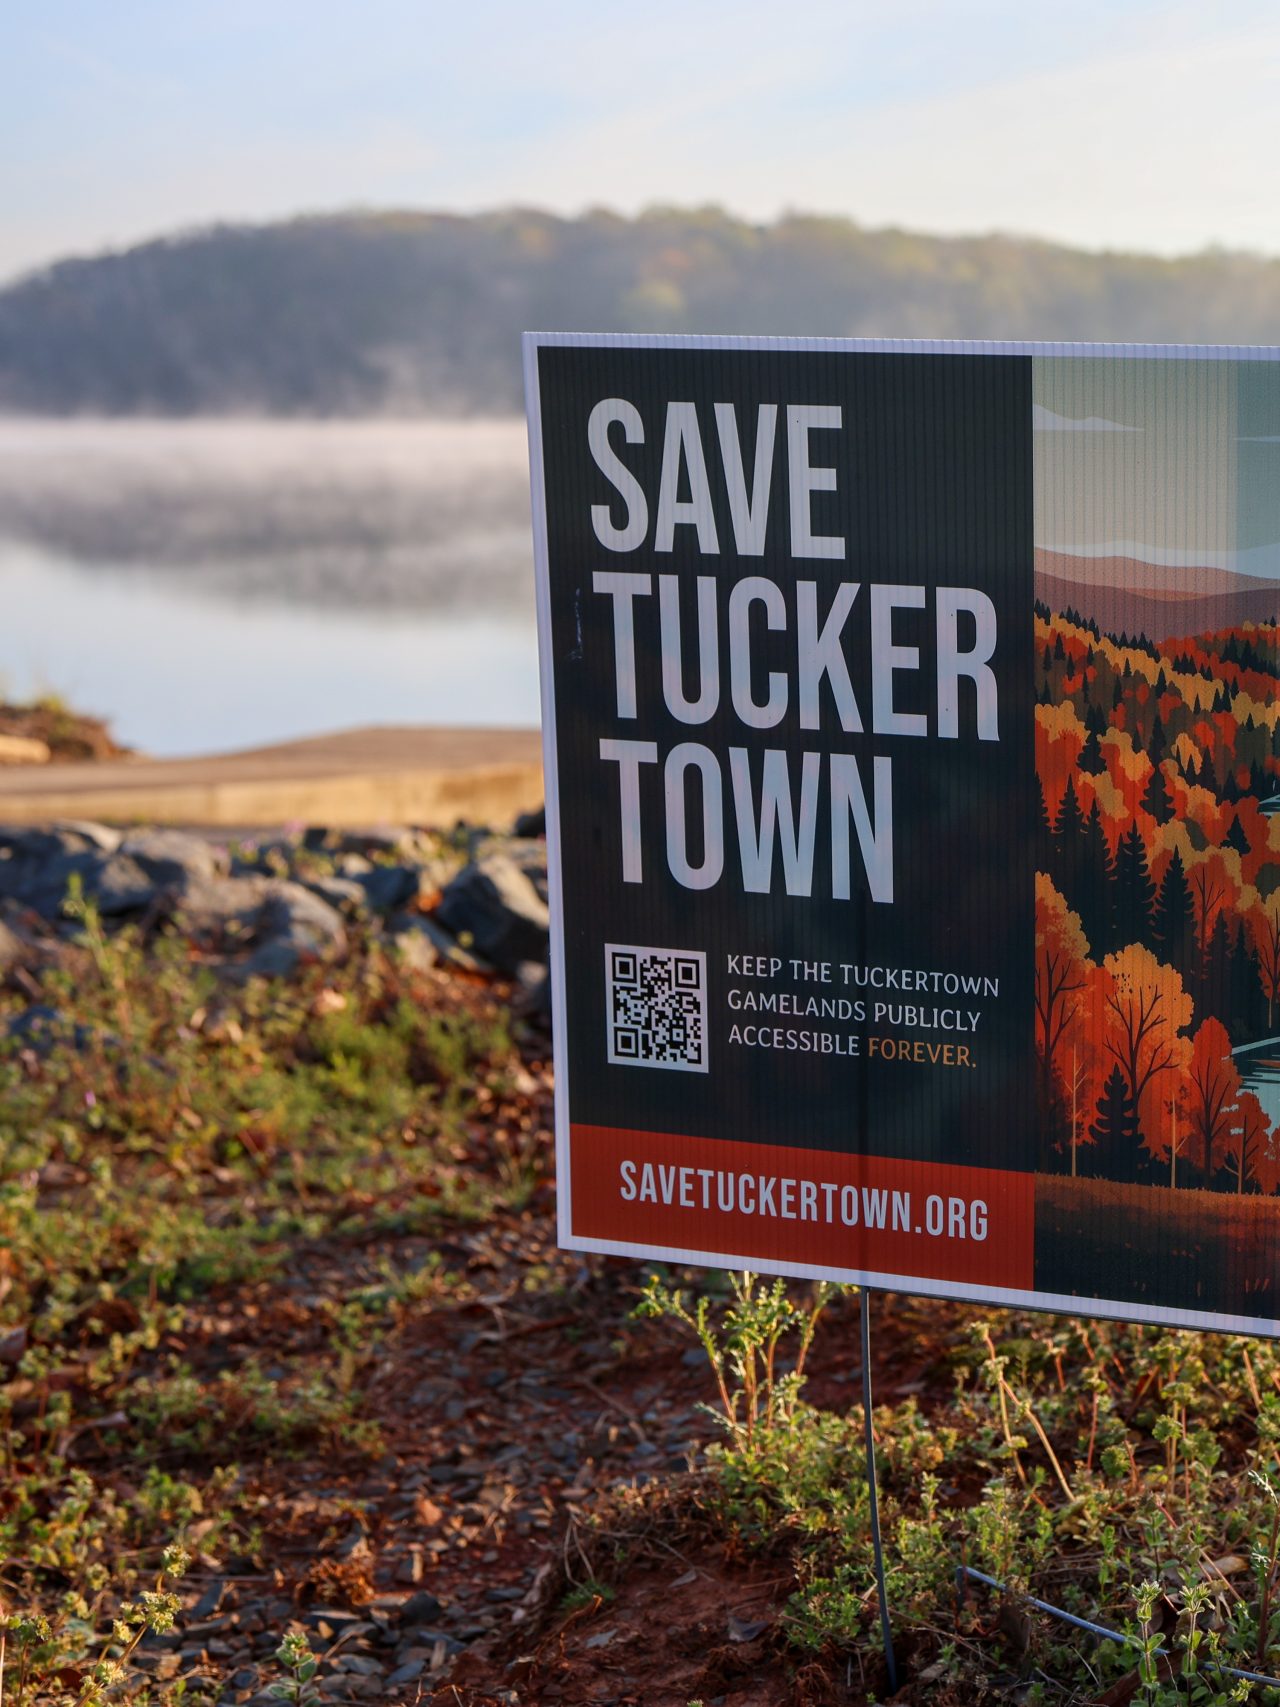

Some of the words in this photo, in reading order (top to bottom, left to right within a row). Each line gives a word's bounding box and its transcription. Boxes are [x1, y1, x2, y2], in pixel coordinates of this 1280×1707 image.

[587, 397, 846, 560] SAVE
[592, 571, 1000, 742] TUCKER
[599, 738, 894, 904] TOWN
[727, 954, 782, 977] KEEP
[789, 960, 832, 984] THE
[839, 964, 999, 997] TUCKERTOWN
[727, 989, 866, 1022] GAMELANDS
[873, 1003, 981, 1032] PUBLICLY
[728, 1025, 860, 1056] ACCESSIBLE
[868, 1037, 976, 1068] FOREVER.
[619, 1160, 989, 1241] SAVETUCKERTOWN.ORG
